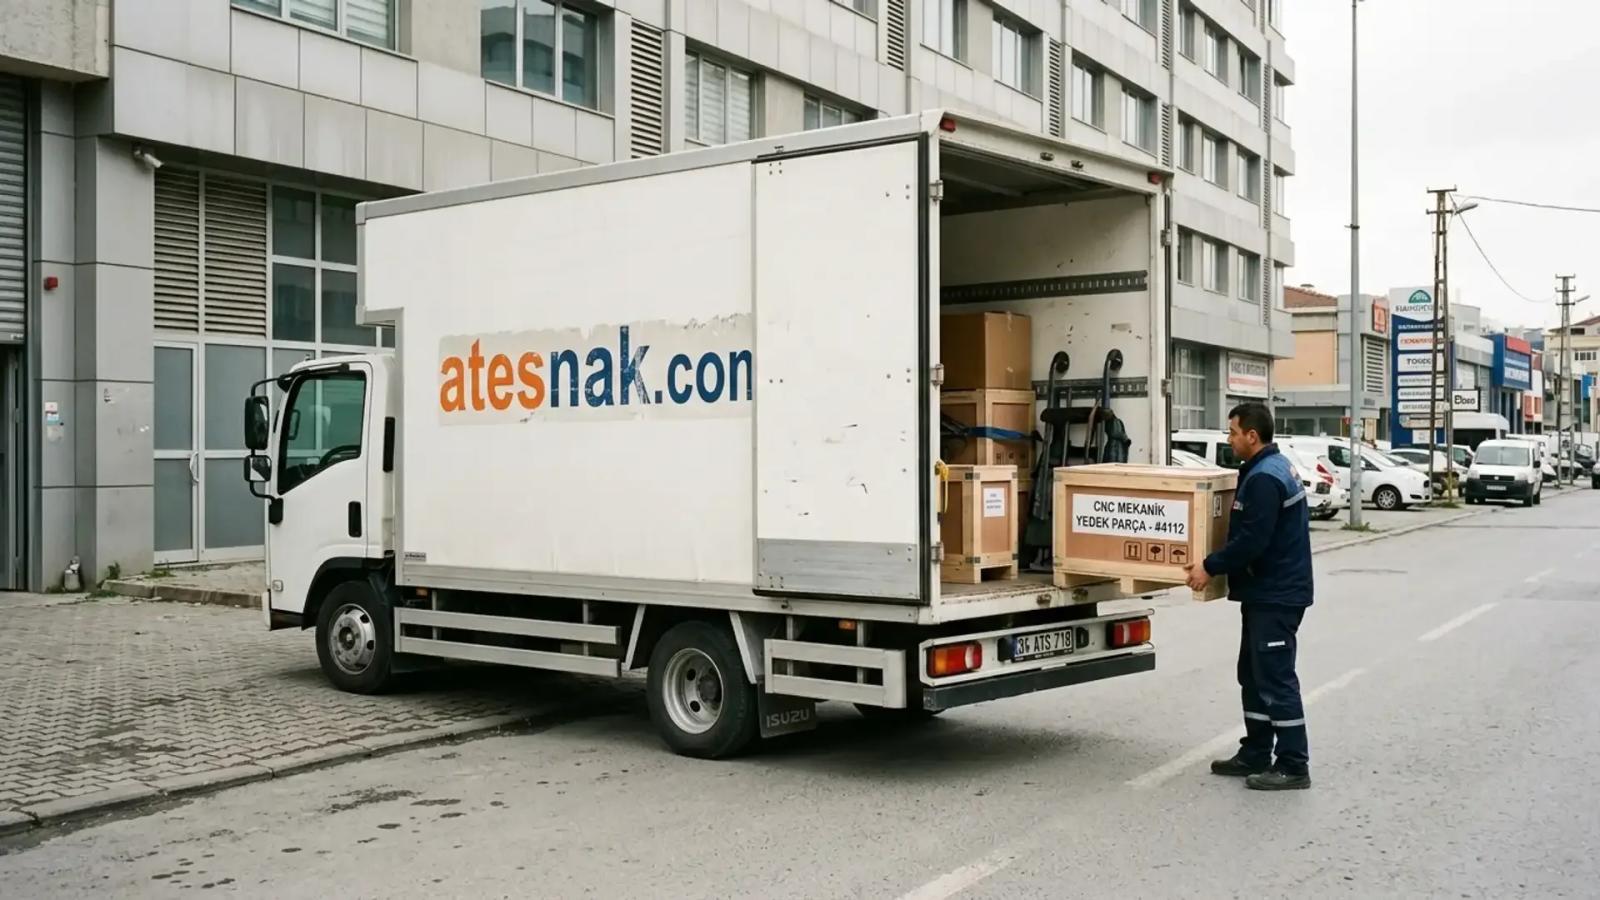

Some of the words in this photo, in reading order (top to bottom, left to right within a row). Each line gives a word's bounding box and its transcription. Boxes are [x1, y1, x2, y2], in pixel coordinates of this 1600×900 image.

[1093, 500, 1115, 513] CNC
[1117, 502, 1166, 517] MEKANİK
[1076, 515, 1109, 529] YEDEK
[1111, 518, 1146, 534] PARÇA
[1154, 521, 1185, 535] #4112
[1034, 634, 1051, 652] ATS
[1054, 631, 1071, 648] 718
[766, 709, 809, 729] ISUZU
